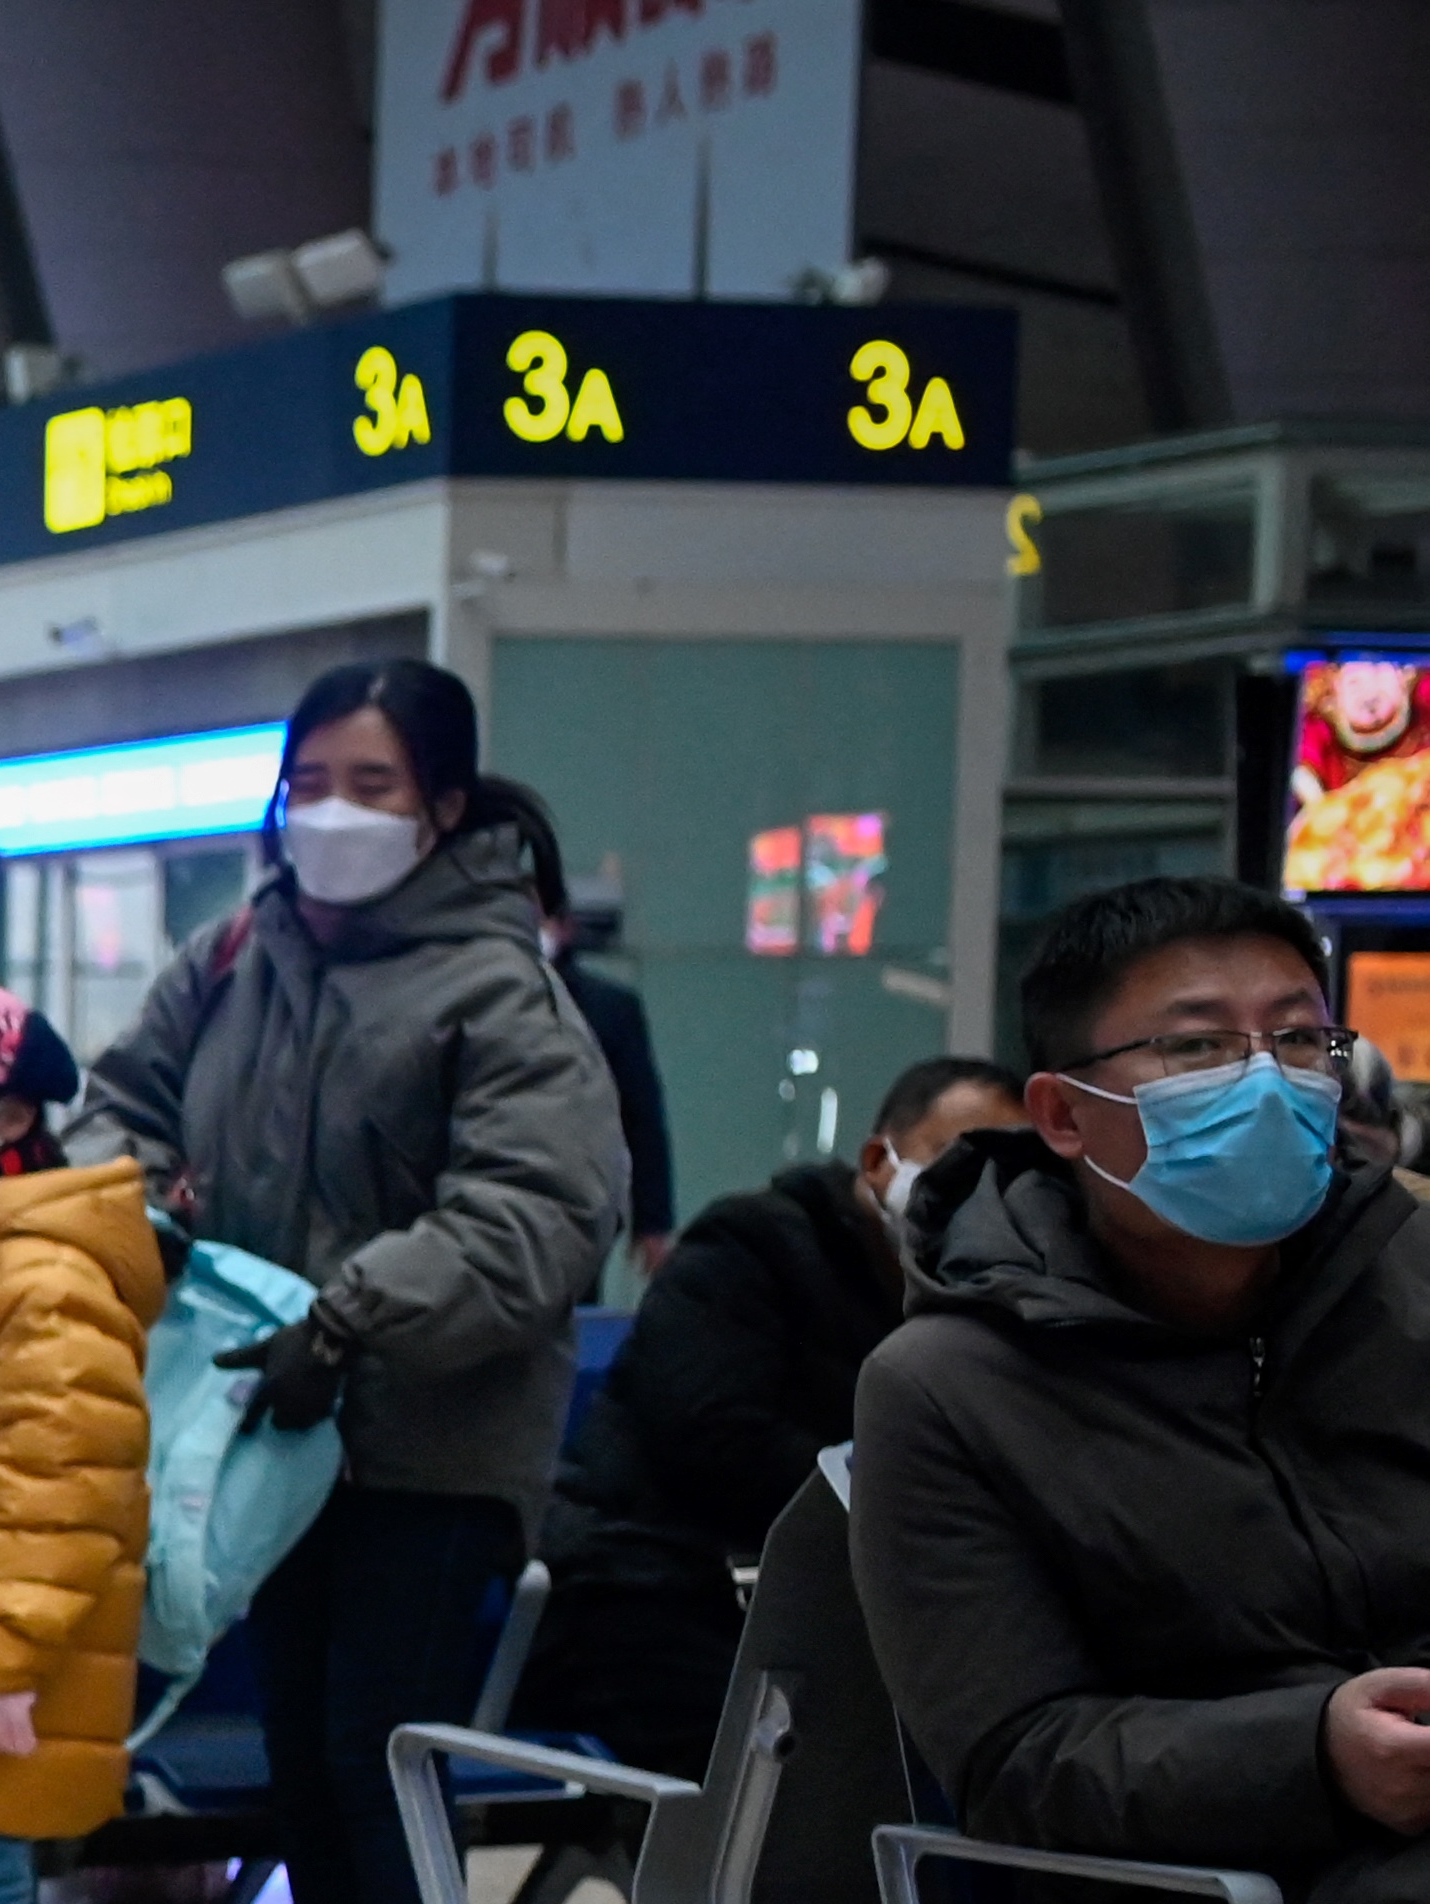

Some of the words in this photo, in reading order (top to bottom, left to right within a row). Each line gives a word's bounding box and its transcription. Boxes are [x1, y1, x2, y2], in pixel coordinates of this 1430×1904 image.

[354, 346, 432, 457] 3A
[503, 330, 626, 444] 3A
[847, 339, 966, 452] 3A
